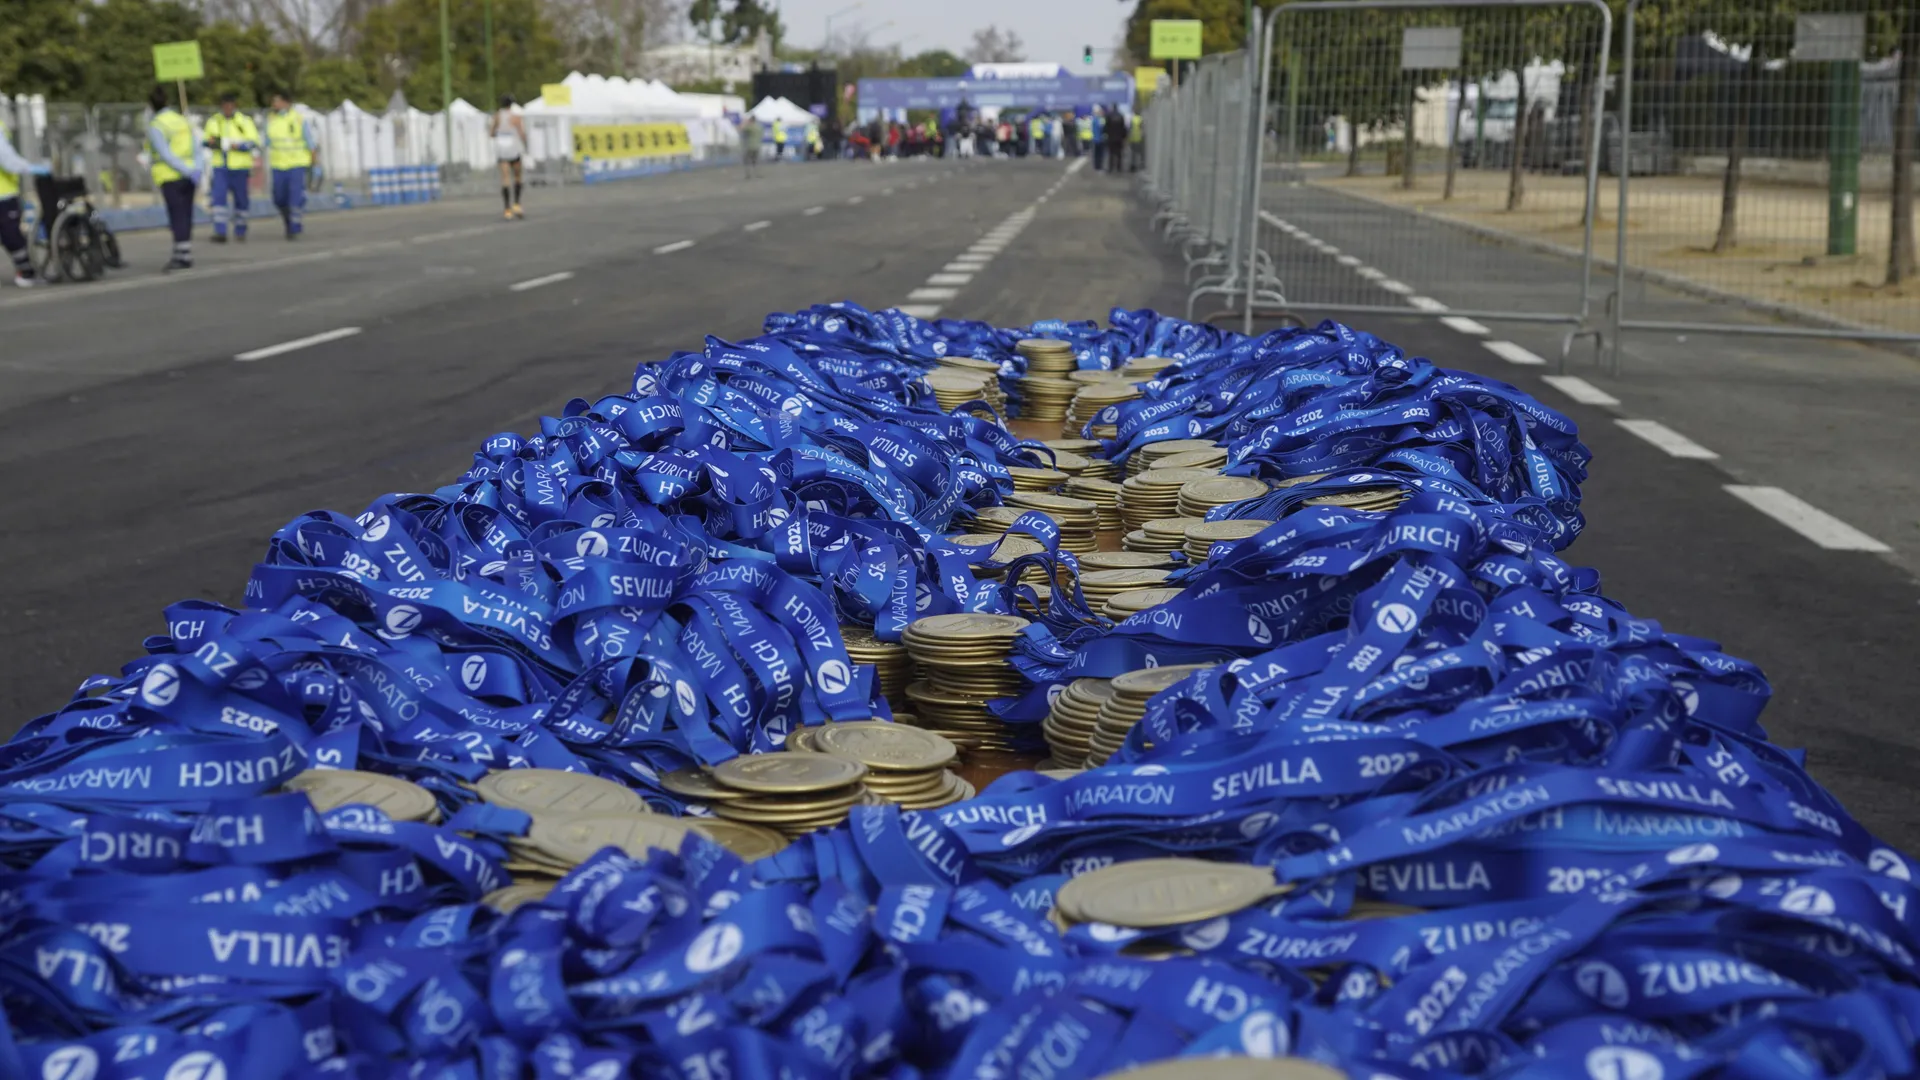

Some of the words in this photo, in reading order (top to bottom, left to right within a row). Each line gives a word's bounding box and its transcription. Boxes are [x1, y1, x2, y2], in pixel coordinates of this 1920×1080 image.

[640, 404, 682, 423] URICH
[1296, 409, 1324, 426] 2023
[1403, 408, 1430, 418] 2023
[1144, 426, 1169, 437] 2023
[870, 436, 917, 467] SEVILLA
[1388, 451, 1450, 475] MARATÓN
[649, 460, 699, 482] ZURICH
[1532, 454, 1556, 504] ZURICH
[1376, 525, 1460, 552] ZURICH
[388, 587, 433, 599] 2023
[610, 575, 673, 598] SEVILLA
[463, 596, 551, 650] SEVILLA
[784, 595, 833, 651] ZURICH
[1121, 608, 1183, 630] ARATÓN
[178, 746, 296, 787] ZURICH
[941, 804, 1047, 828] ZURICH
[1064, 782, 1176, 816] MARATÓN
[1211, 757, 1323, 800] SEVILLA
[1596, 777, 1736, 810] SEVILLA
[1238, 928, 1358, 959] ZURICH
[1406, 965, 1468, 1036] 2023
